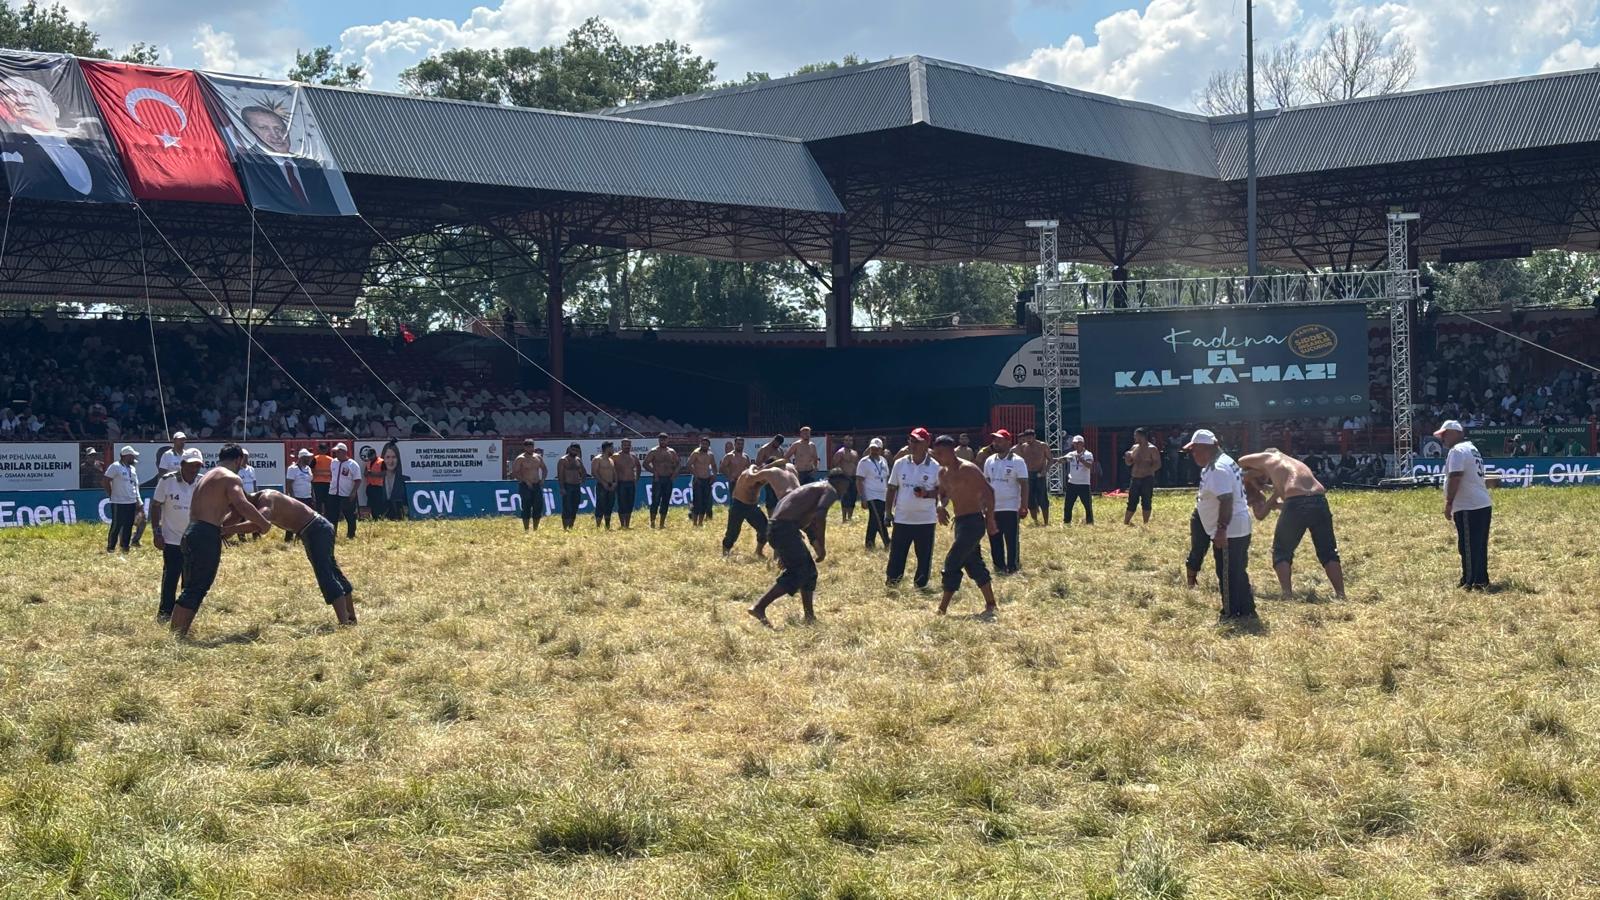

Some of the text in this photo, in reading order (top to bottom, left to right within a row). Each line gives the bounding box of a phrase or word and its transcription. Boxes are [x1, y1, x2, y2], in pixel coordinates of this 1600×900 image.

[1207, 349, 1245, 366] EL
[1115, 363, 1337, 388] KAL-KA-MAZ!
[1549, 463, 1589, 483] CW
[412, 490, 454, 514] CW
